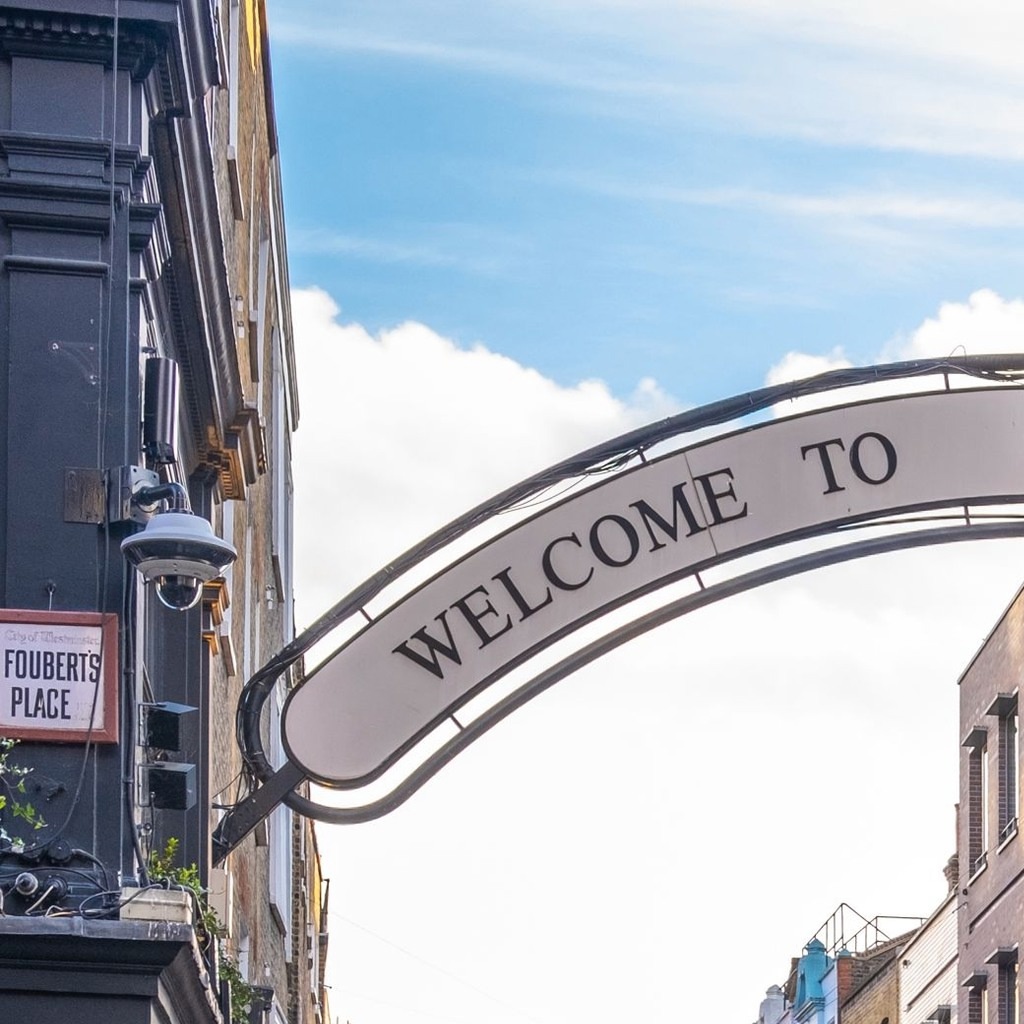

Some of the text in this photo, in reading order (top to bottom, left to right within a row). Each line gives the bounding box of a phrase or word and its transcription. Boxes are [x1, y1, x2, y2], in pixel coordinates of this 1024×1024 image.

[391, 431, 898, 680] WELCOME TO
[4, 648, 100, 683] FOUBERT'S
[11, 687, 71, 720] PLACE
